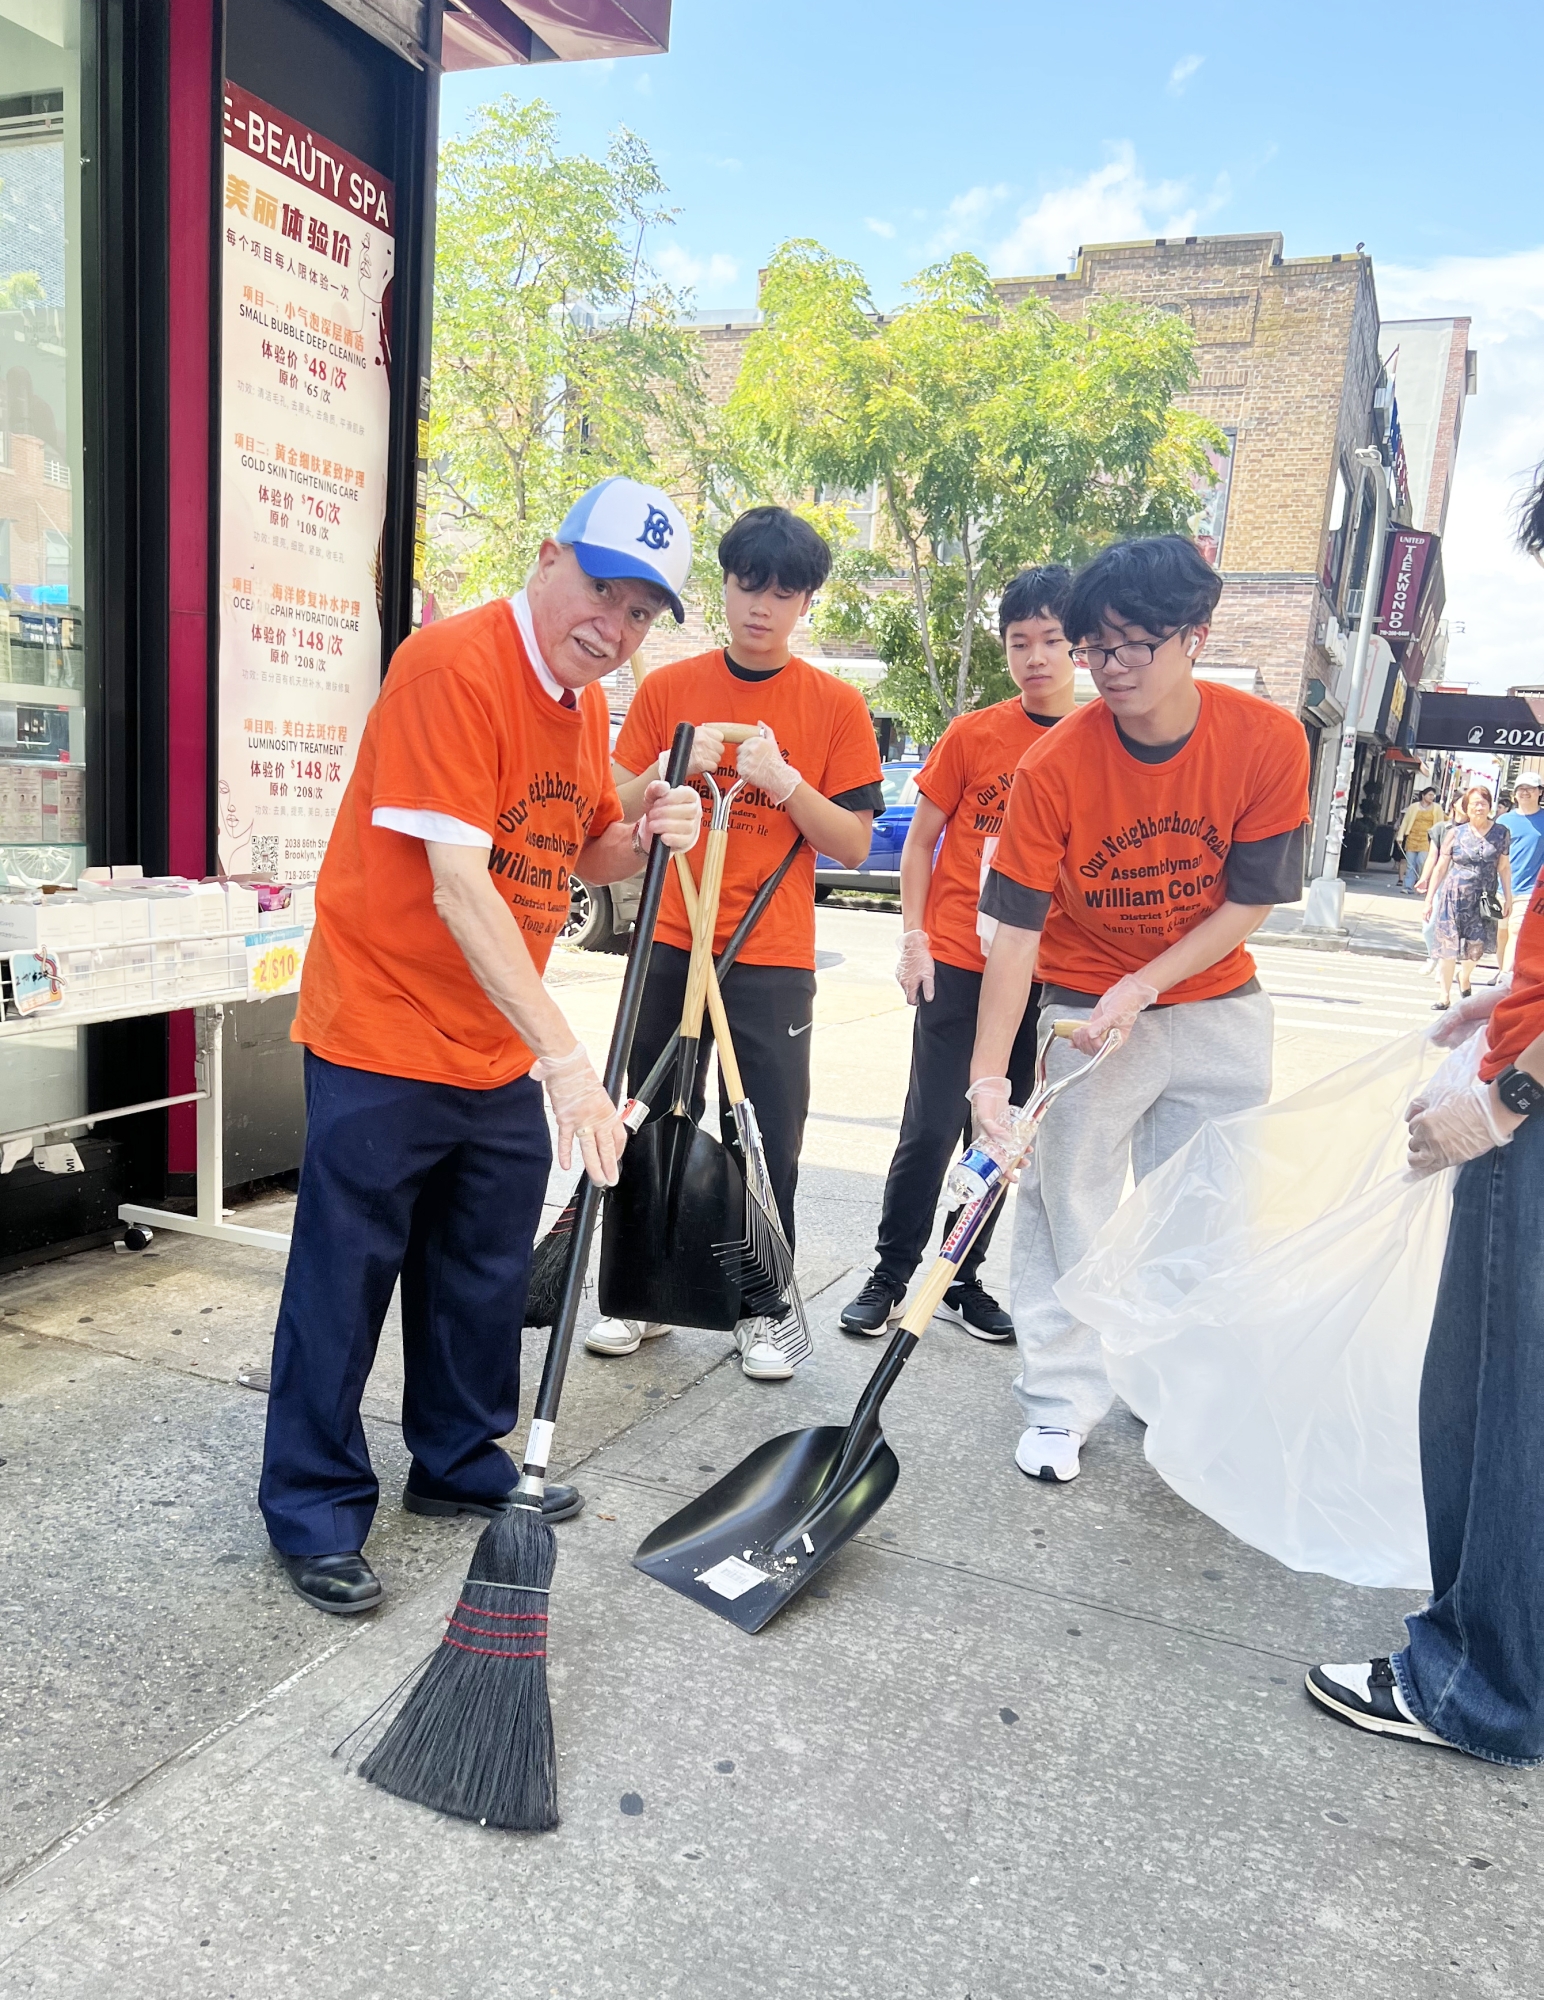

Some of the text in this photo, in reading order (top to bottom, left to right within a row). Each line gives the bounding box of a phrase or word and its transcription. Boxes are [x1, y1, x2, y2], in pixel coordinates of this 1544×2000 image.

[349, 173, 390, 228] SPA
[224, 173, 351, 268] 美丽体验价
[226, 228, 350, 301] 每个项目每人限体验一次
[239, 304, 367, 370] SMALL BUBBLE DEEP CLEANING
[262, 338, 298, 371] 体验价
[279, 369, 299, 391] 原价
[241, 454, 359, 502] GOLD SKIN TIGHTENING CARE
[258, 484, 294, 511] 体验价
[269, 509, 290, 529] 原价
[1400, 535, 1426, 545] UNITED
[1388, 544, 1418, 629] TAEKWONDO
[295, 609, 339, 628] HYDRATION
[340, 618, 360, 632] CARE
[251, 623, 287, 647] 体验价
[270, 648, 290, 666] 原价
[248, 736, 344, 756] LUMINOSITY TREATMENT
[251, 760, 285, 780] 体验价
[269, 782, 289, 797] 原价
[976, 784, 999, 807] Our
[497, 798, 529, 834] Our
[730, 819, 755, 835] Larry
[756, 824, 769, 837] He
[284, 838, 328, 849] 2038 86th Str
[1079, 851, 1109, 879] Our
[1102, 810, 1206, 858] Neighborhood
[284, 850, 317, 862] Brooklyn,
[1084, 887, 1165, 909] William
[522, 914, 545, 936] Tong
[1120, 912, 1162, 921] District
[1103, 923, 1136, 936] Nancy
[1138, 923, 1165, 937] Tong
